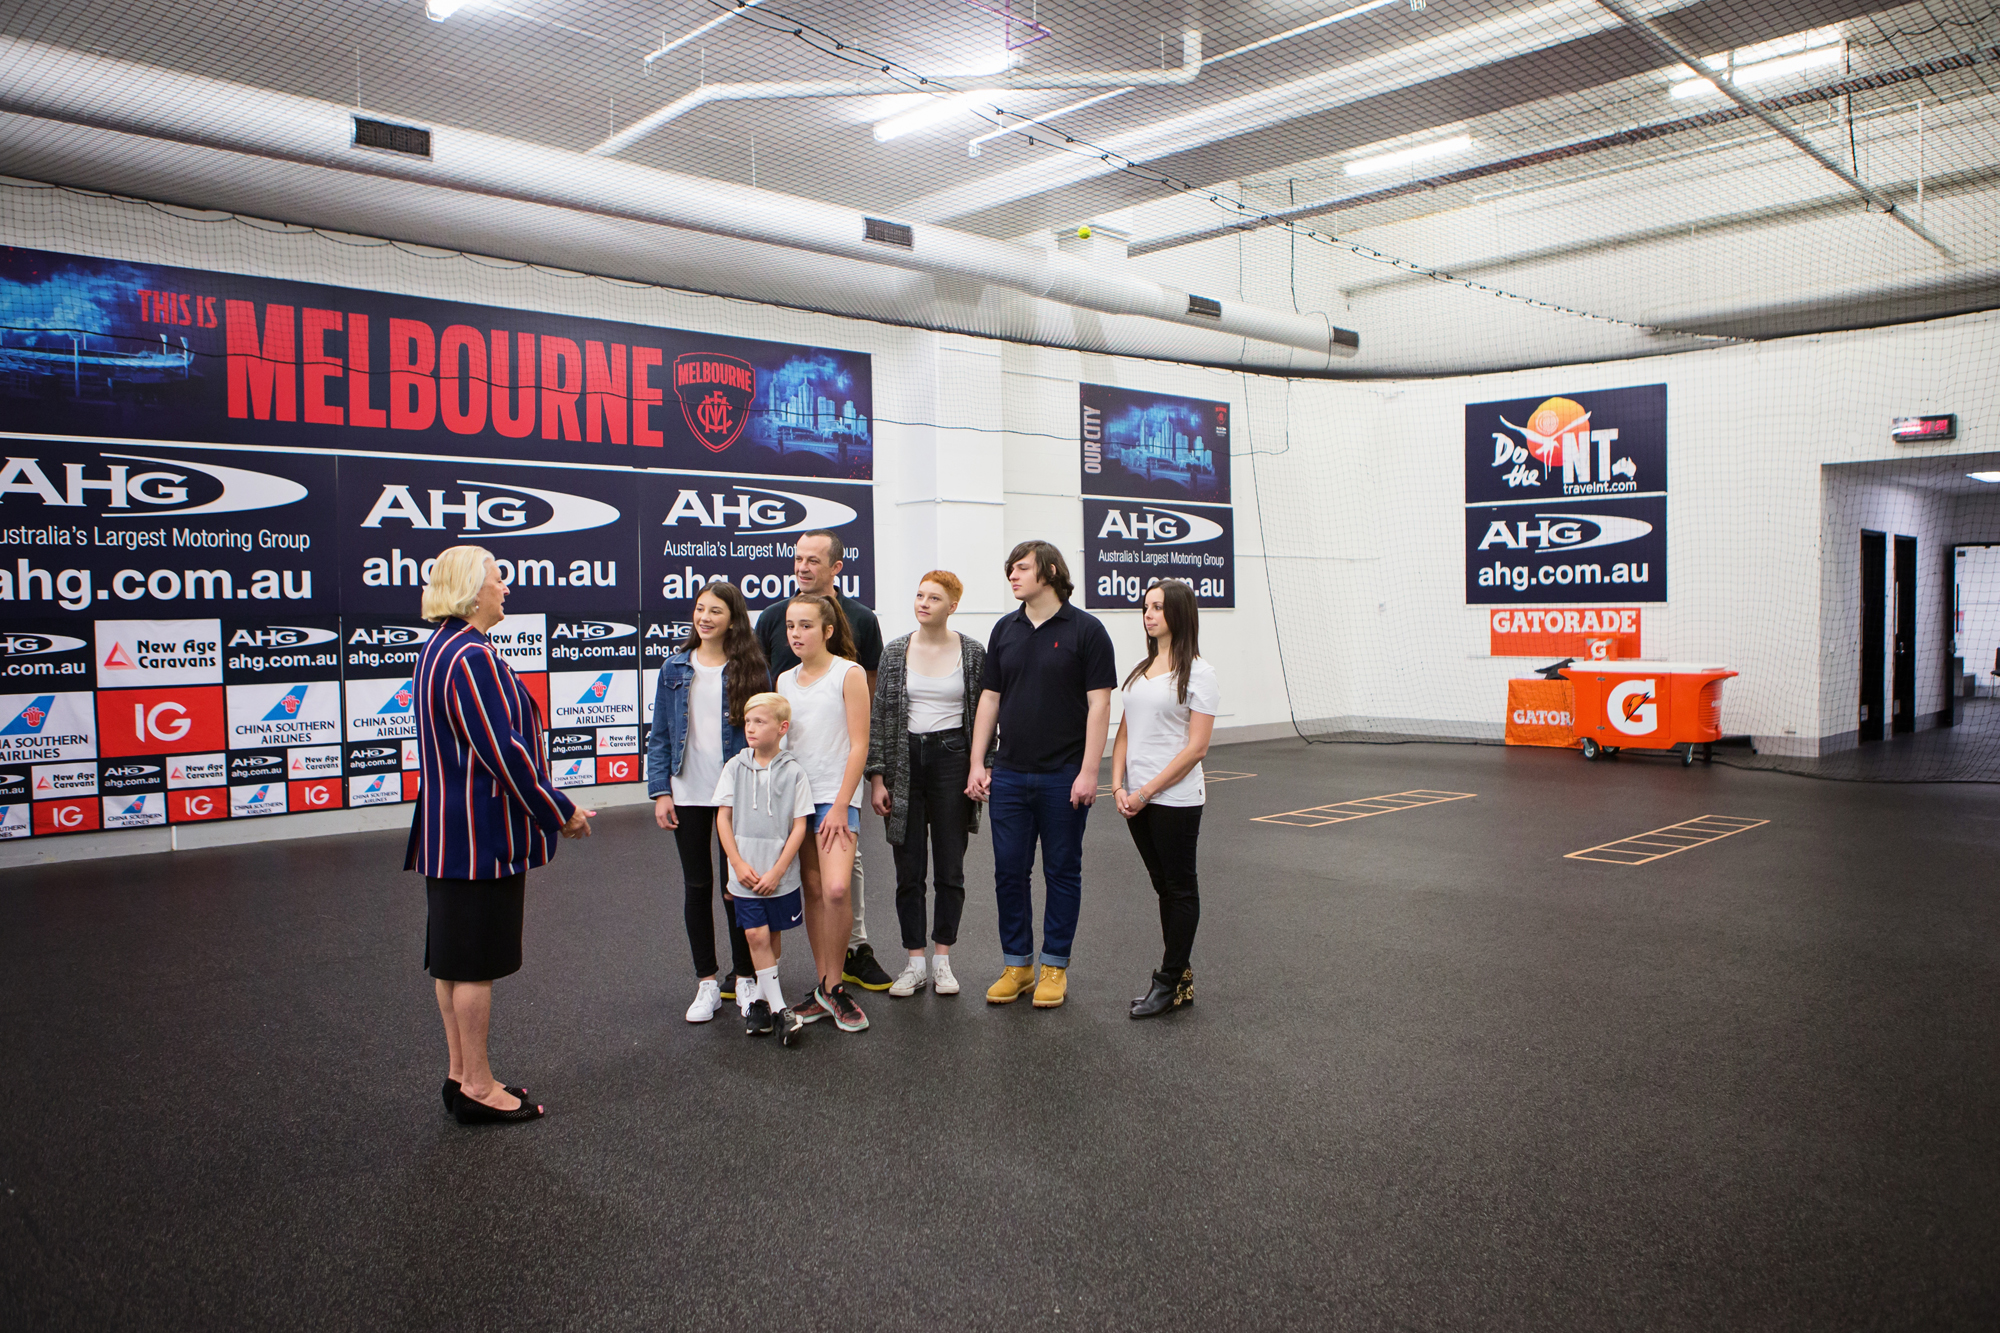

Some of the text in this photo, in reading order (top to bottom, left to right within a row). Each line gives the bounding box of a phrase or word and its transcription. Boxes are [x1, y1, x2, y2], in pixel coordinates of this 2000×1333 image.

[137, 289, 218, 329] THIS IS
[225, 298, 664, 448] MELBOURNE
[678, 361, 752, 393] MELBOURNE
[1083, 404, 1102, 474] OUR CITY
[1491, 432, 1529, 467] Do
[1562, 428, 1619, 484] NT
[0, 456, 190, 508] AHG
[1502, 464, 1541, 488] the
[1563, 479, 1637, 495] travelnt.com
[360, 484, 527, 530] AHG
[662, 489, 788, 528] AHG
[1097, 509, 1178, 540] AHG
[0, 525, 311, 552] ustralia's Largest Motoring Group
[1477, 520, 1582, 550] AHG
[663, 540, 727, 557] Australia's
[730, 541, 773, 560] Largest
[1098, 549, 1225, 568] Australia's Largest Motoring Group
[1478, 561, 1649, 592] ahg.com.au
[551, 622, 606, 639] AHG
[1492, 610, 1637, 634] GATORADE
[228, 628, 298, 648] AHG
[348, 628, 409, 645] AHG
[517, 631, 543, 646] Age
[645, 623, 692, 639] AHG
[0, 636, 39, 653] HG
[136, 638, 216, 657] New Age
[500, 647, 543, 657] ravans
[551, 644, 637, 660] ahg.com.au
[138, 653, 217, 669] Caravans
[228, 651, 337, 672] ahg.com.au
[348, 650, 419, 667] ahg.com
[1, 662, 86, 677] .com.au
[556, 704, 634, 716] CHINA SOUTHERN
[1606, 679, 1658, 736] G
[134, 701, 192, 743] IG
[353, 715, 416, 728] CHINA SOUT
[576, 714, 616, 725] AIRLINES
[1513, 709, 1575, 727] GATOR
[235, 720, 335, 736] CHINA SOUTHERN
[377, 725, 417, 737] AIRLINE
[15, 734, 89, 749] SOUTHERN
[261, 732, 312, 745] AIRLINES
[552, 736, 578, 744] AHG
[350, 749, 380, 759] AHG
[552, 744, 592, 754] ahg.com.au
[185, 763, 224, 772] New Age
[231, 758, 264, 768] AHG
[305, 755, 339, 764] New Age
[305, 763, 339, 771] Caravans
[350, 758, 397, 769] ahg.com.au
[53, 772, 95, 782] New Age
[104, 766, 139, 777] AHG
[186, 771, 224, 780] Caravans
[231, 767, 282, 778] ahg.com.au
[608, 761, 629, 778] IG
[53, 780, 95, 789] Caravans
[104, 776, 160, 788] ahg.com.au
[304, 785, 330, 806] IG
[185, 795, 213, 816] IG
[53, 805, 83, 828] IG
